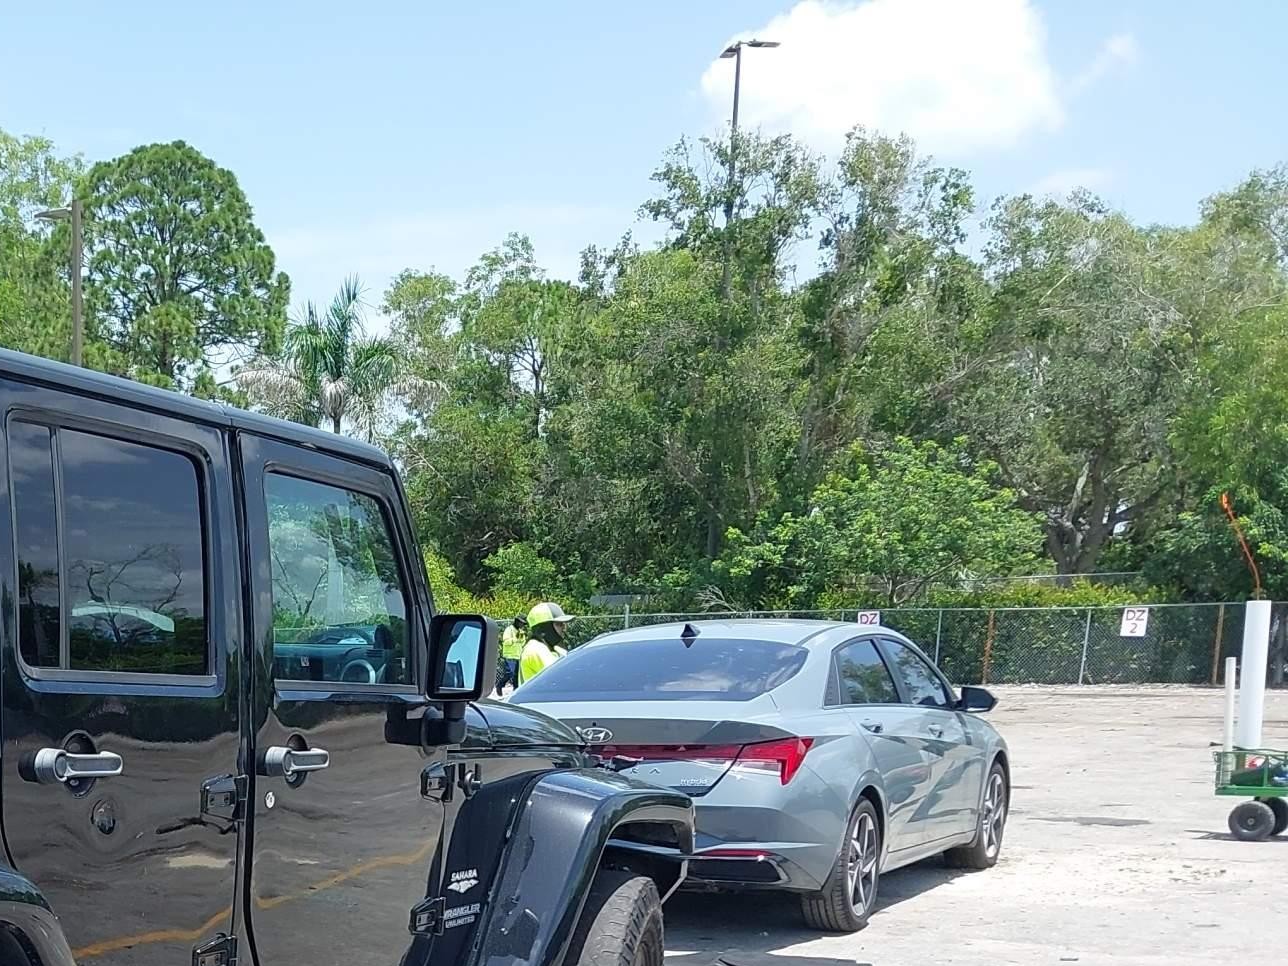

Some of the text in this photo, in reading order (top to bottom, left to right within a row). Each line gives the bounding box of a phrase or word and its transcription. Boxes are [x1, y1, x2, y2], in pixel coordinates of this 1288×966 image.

[859, 612, 879, 625] DZ
[1126, 609, 1146, 621] DZ
[1129, 622, 1138, 634] 2
[450, 868, 478, 881] SAHARA
